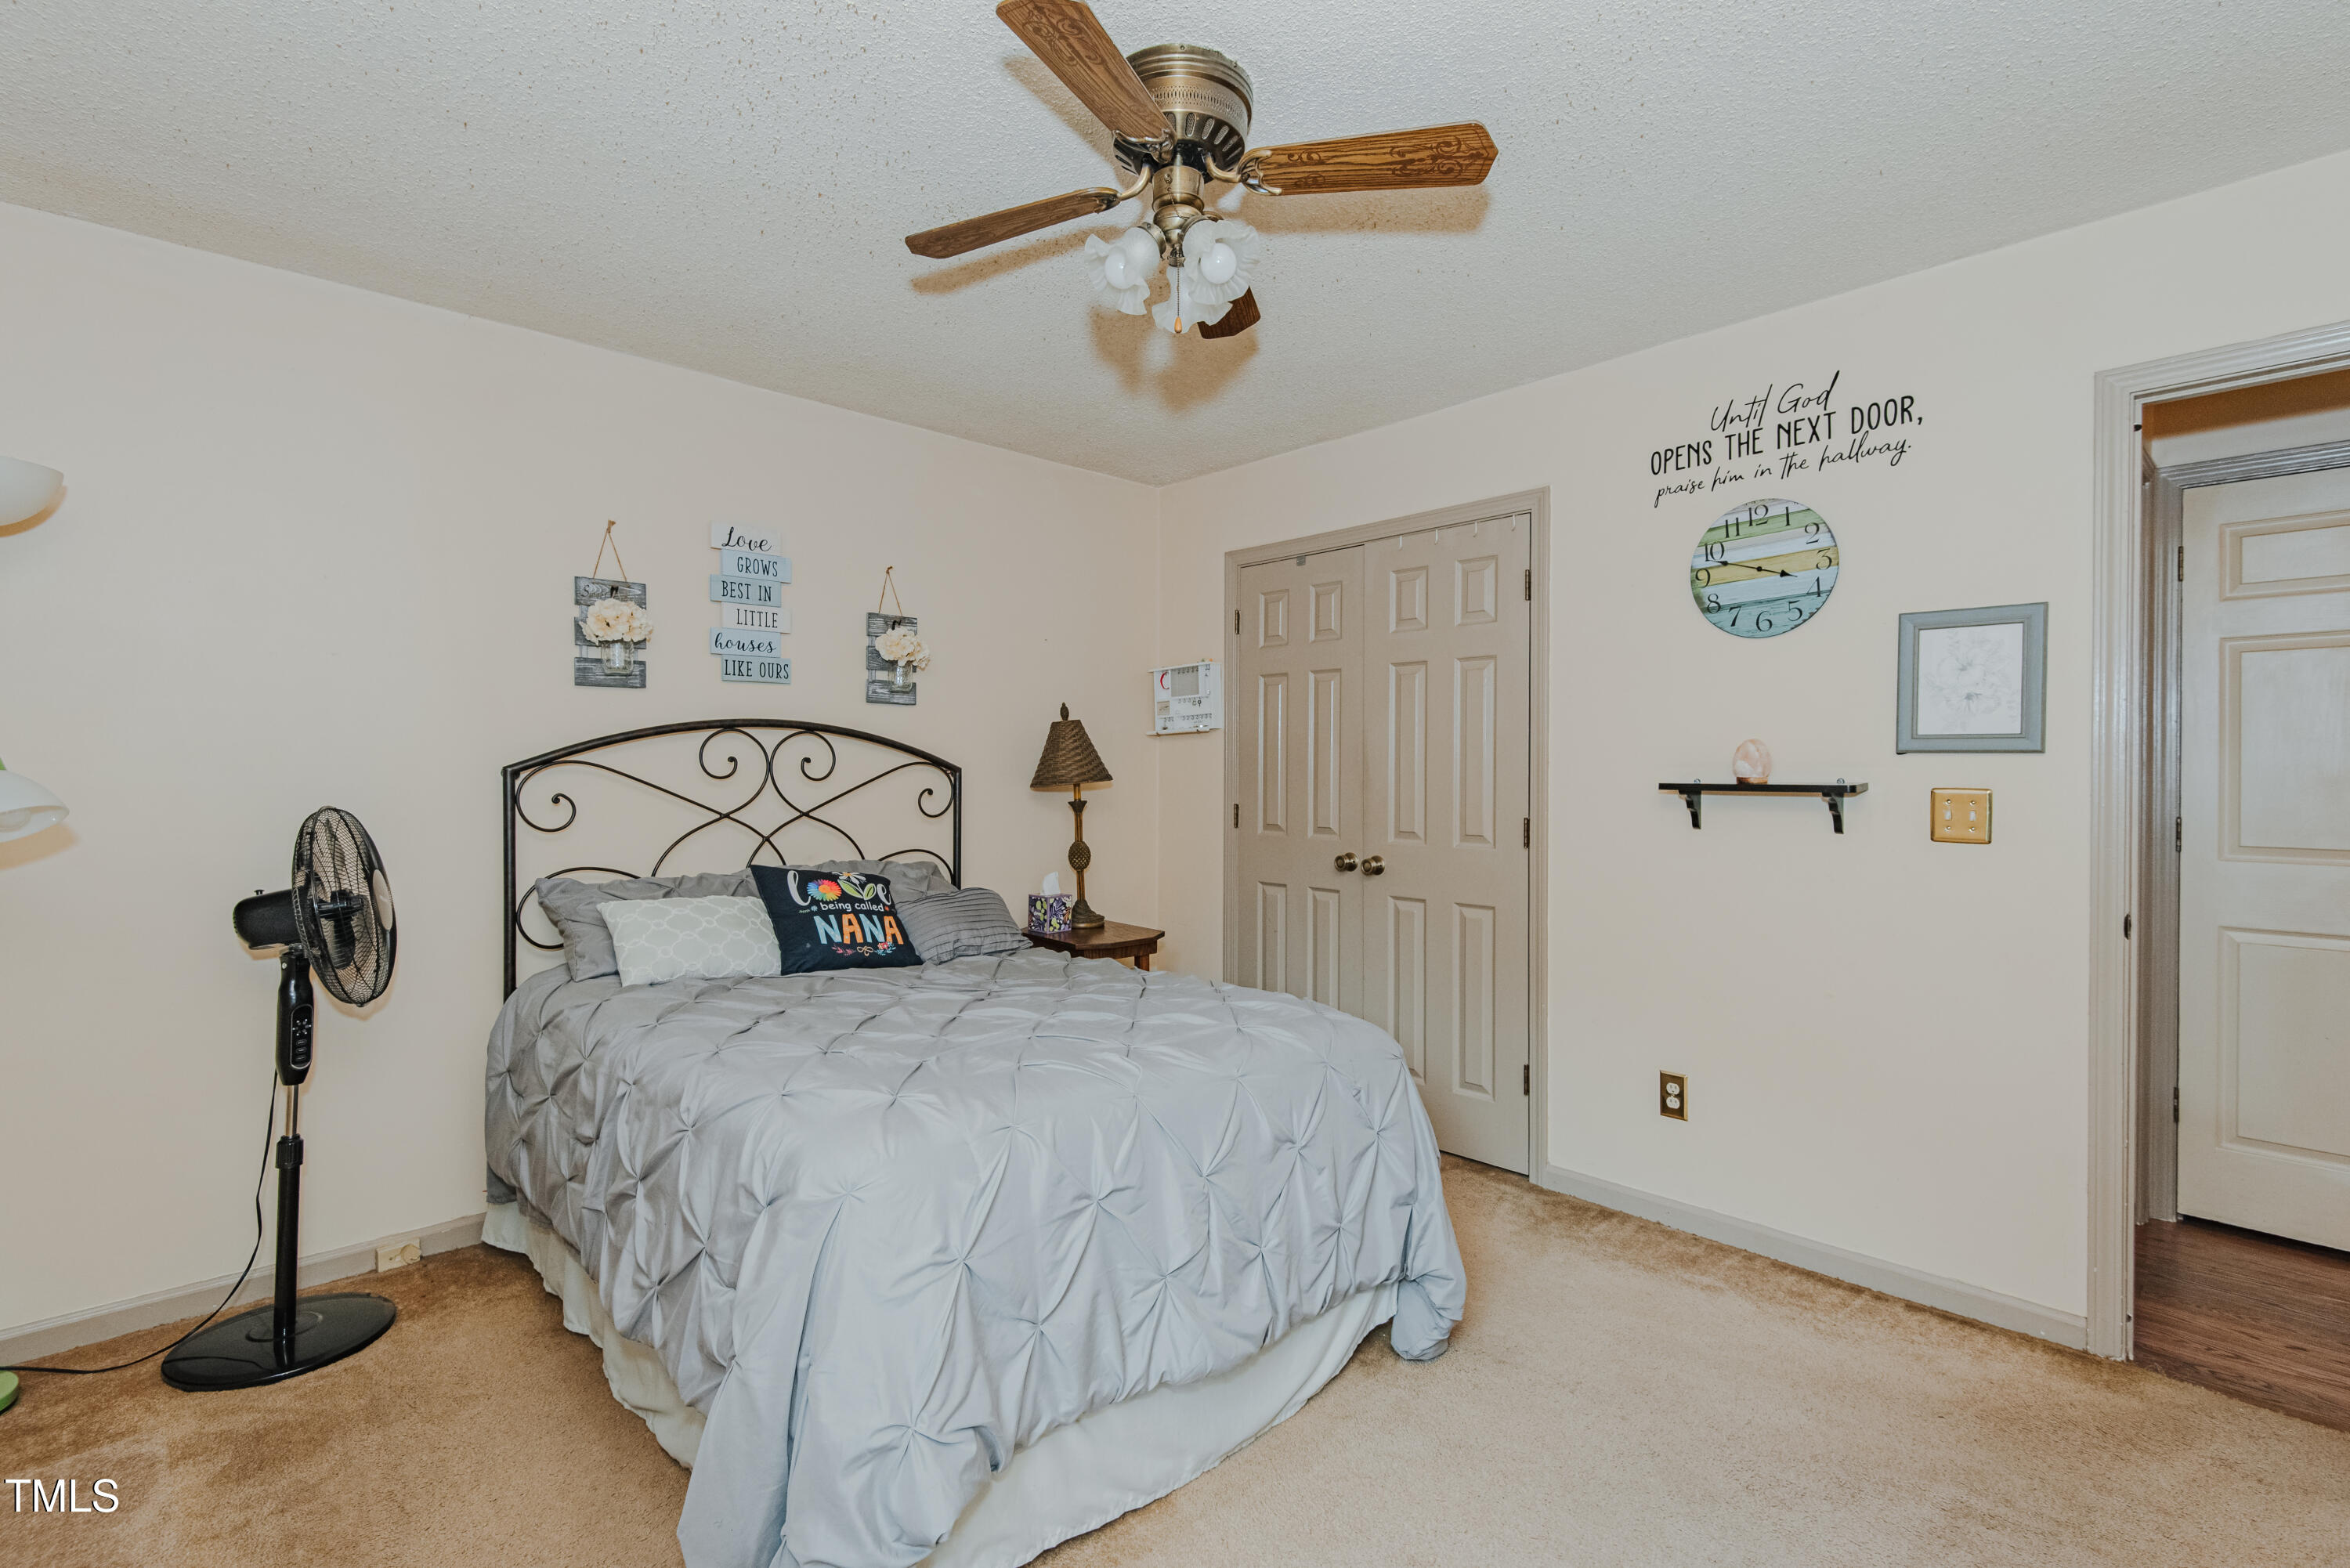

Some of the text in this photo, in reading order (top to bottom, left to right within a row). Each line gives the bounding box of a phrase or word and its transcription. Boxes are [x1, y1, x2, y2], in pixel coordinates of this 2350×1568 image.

[1711, 370, 1840, 432] Until God
[1650, 395, 1923, 475] OPENS THE NEXT DOOR,
[1654, 431, 1912, 508] praise him in the hallway.
[1748, 504, 1769, 527] 12
[1785, 506, 1791, 526] 1
[1725, 517, 1741, 538] 11
[1804, 522, 1820, 544] 2
[721, 526, 772, 552] Love
[1705, 541, 1725, 562] 10
[1816, 548, 1832, 570] 3
[737, 556, 778, 577] GROWS
[1695, 569, 1711, 588] 9
[1806, 576, 1821, 598] 4
[721, 580, 772, 602] BEST IN
[1706, 593, 1721, 614] 8
[1788, 600, 1802, 622] 5
[736, 609, 778, 628] LITTLE
[1728, 606, 1742, 627] 7
[1755, 610, 1773, 632] 6
[714, 632, 776, 653] houses
[724, 659, 790, 680] LIKE OURS
[819, 901, 885, 912] being called
[813, 913, 904, 945] NANA
